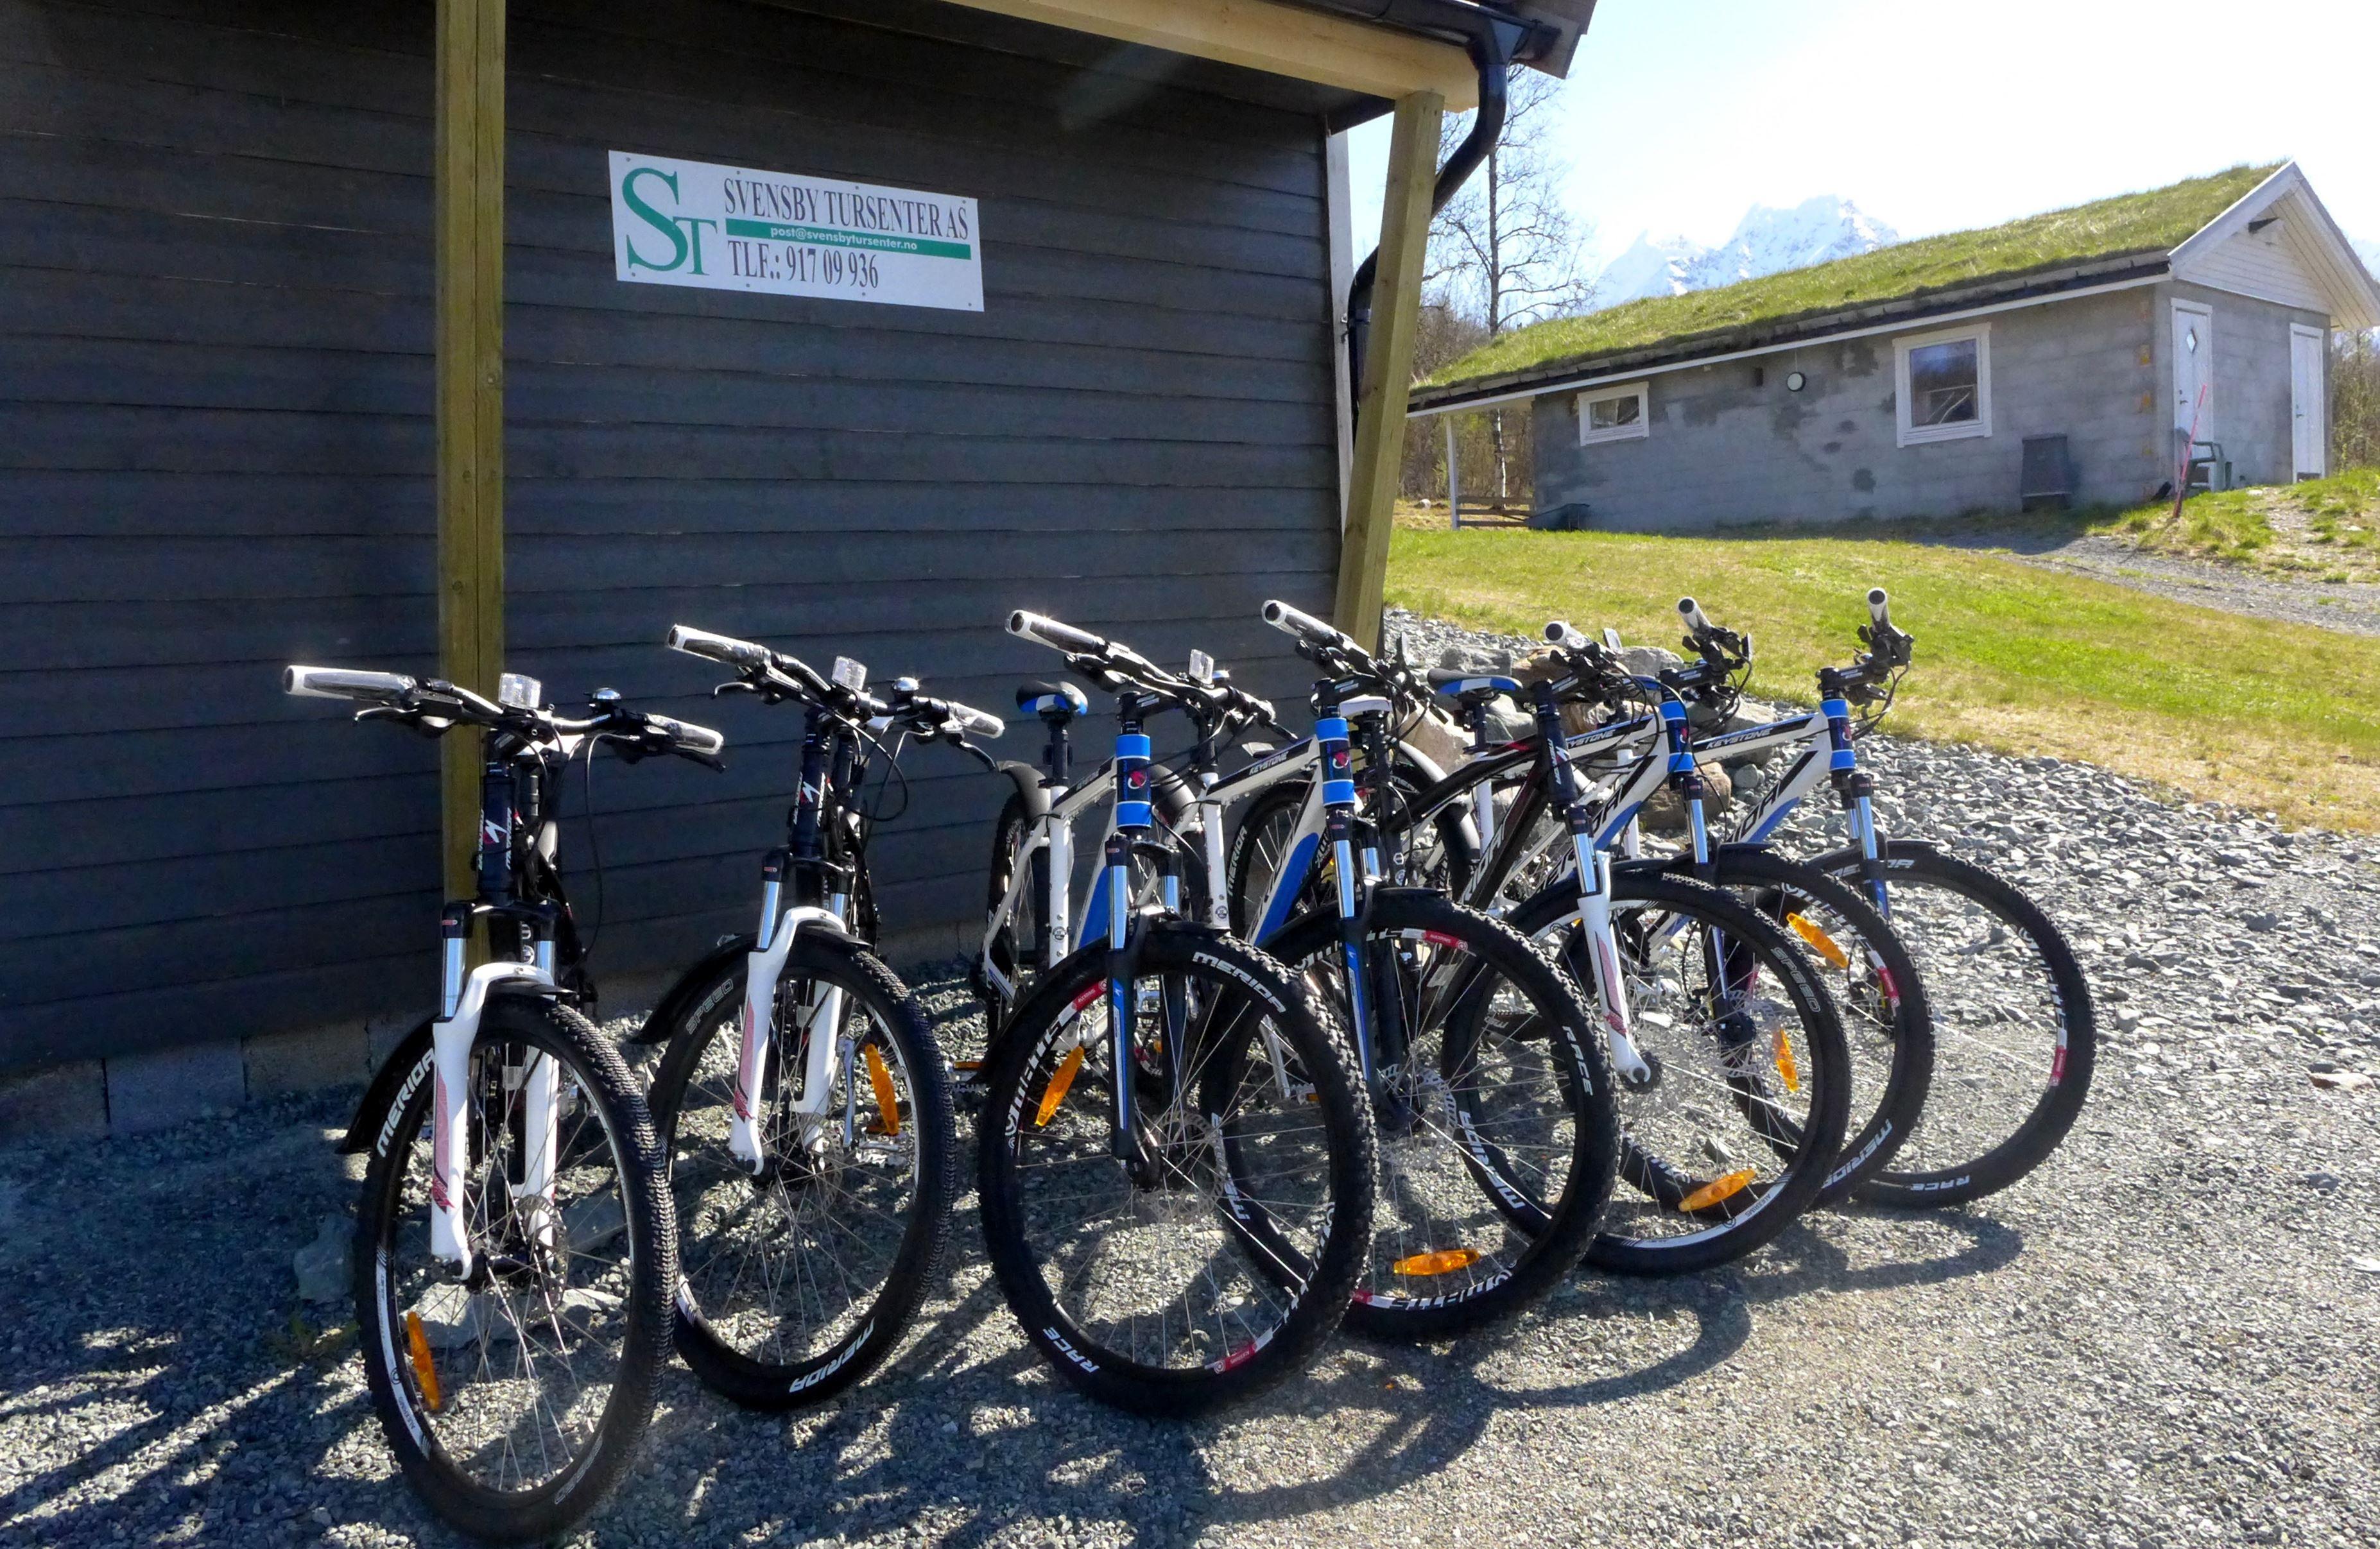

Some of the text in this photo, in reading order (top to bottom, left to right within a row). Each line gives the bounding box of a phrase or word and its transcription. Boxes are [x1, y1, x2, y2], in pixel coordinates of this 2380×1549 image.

[723, 178, 969, 240] SVENSBY TURSENTER AS
[771, 225, 918, 252] post@svensbytursenter.no
[727, 240, 879, 289] TLF.: 917 09 936
[1569, 730, 1614, 748] YSTONE
[1705, 728, 1773, 749] KEYSTONE
[1227, 825, 1248, 897] MERIDA
[686, 978, 734, 1035] SPEED
[1192, 951, 1287, 1014] MERIDA
[1770, 946, 1822, 1013] SPEED
[1562, 1025, 1594, 1097] RACE
[376, 1047, 436, 1158] MERIDA
[1458, 1109, 1526, 1209] MERIDA
[1821, 1118, 1893, 1189] MERIDA
[1910, 1174, 1970, 1192] RACE
[1744, 1193, 1772, 1218] ALEXRIMS
[789, 1315, 876, 1393] MERIDA
[1042, 1326, 1100, 1373] RACE
